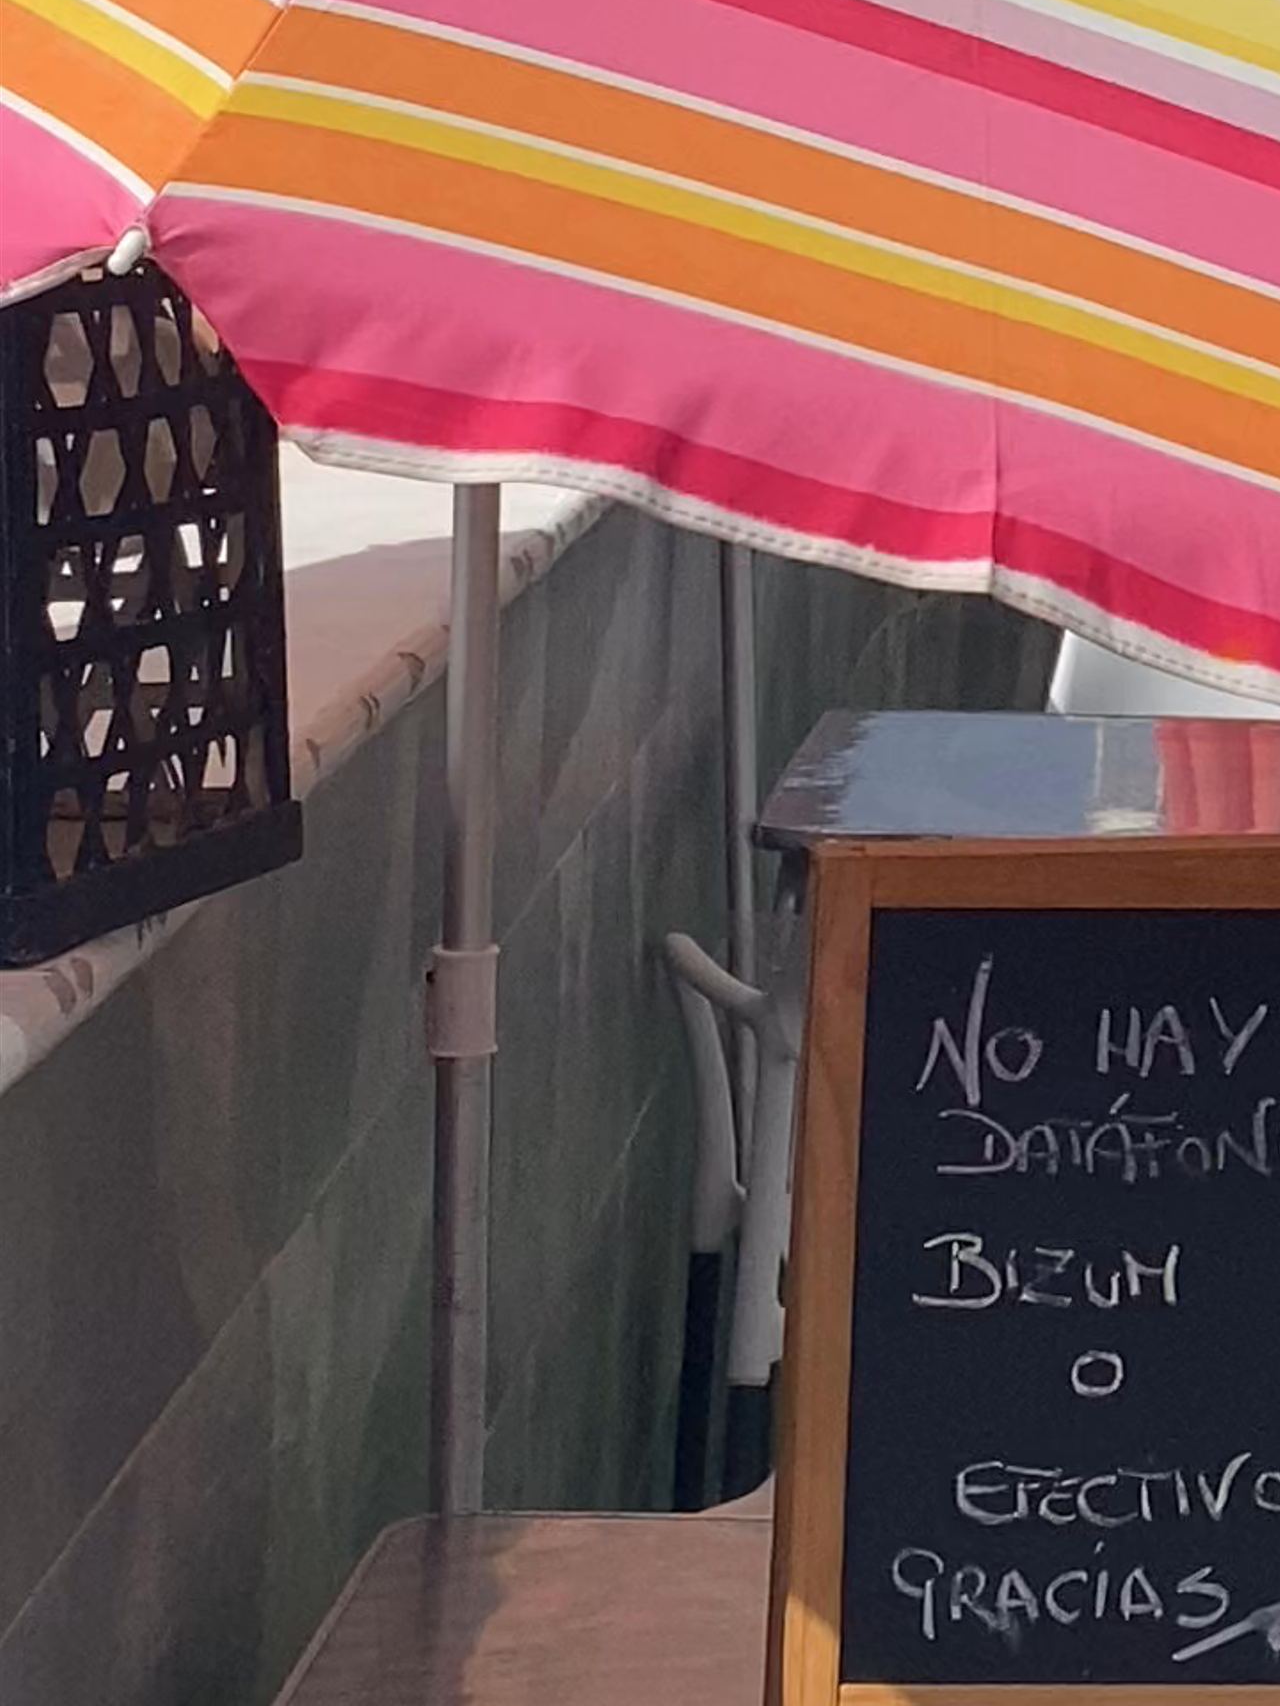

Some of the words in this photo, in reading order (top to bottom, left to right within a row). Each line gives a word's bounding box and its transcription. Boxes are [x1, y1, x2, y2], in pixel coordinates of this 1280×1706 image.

[916, 953, 1043, 1105] NO
[1096, 997, 1268, 1078] HAY
[913, 1233, 1181, 1310] BIZUM
